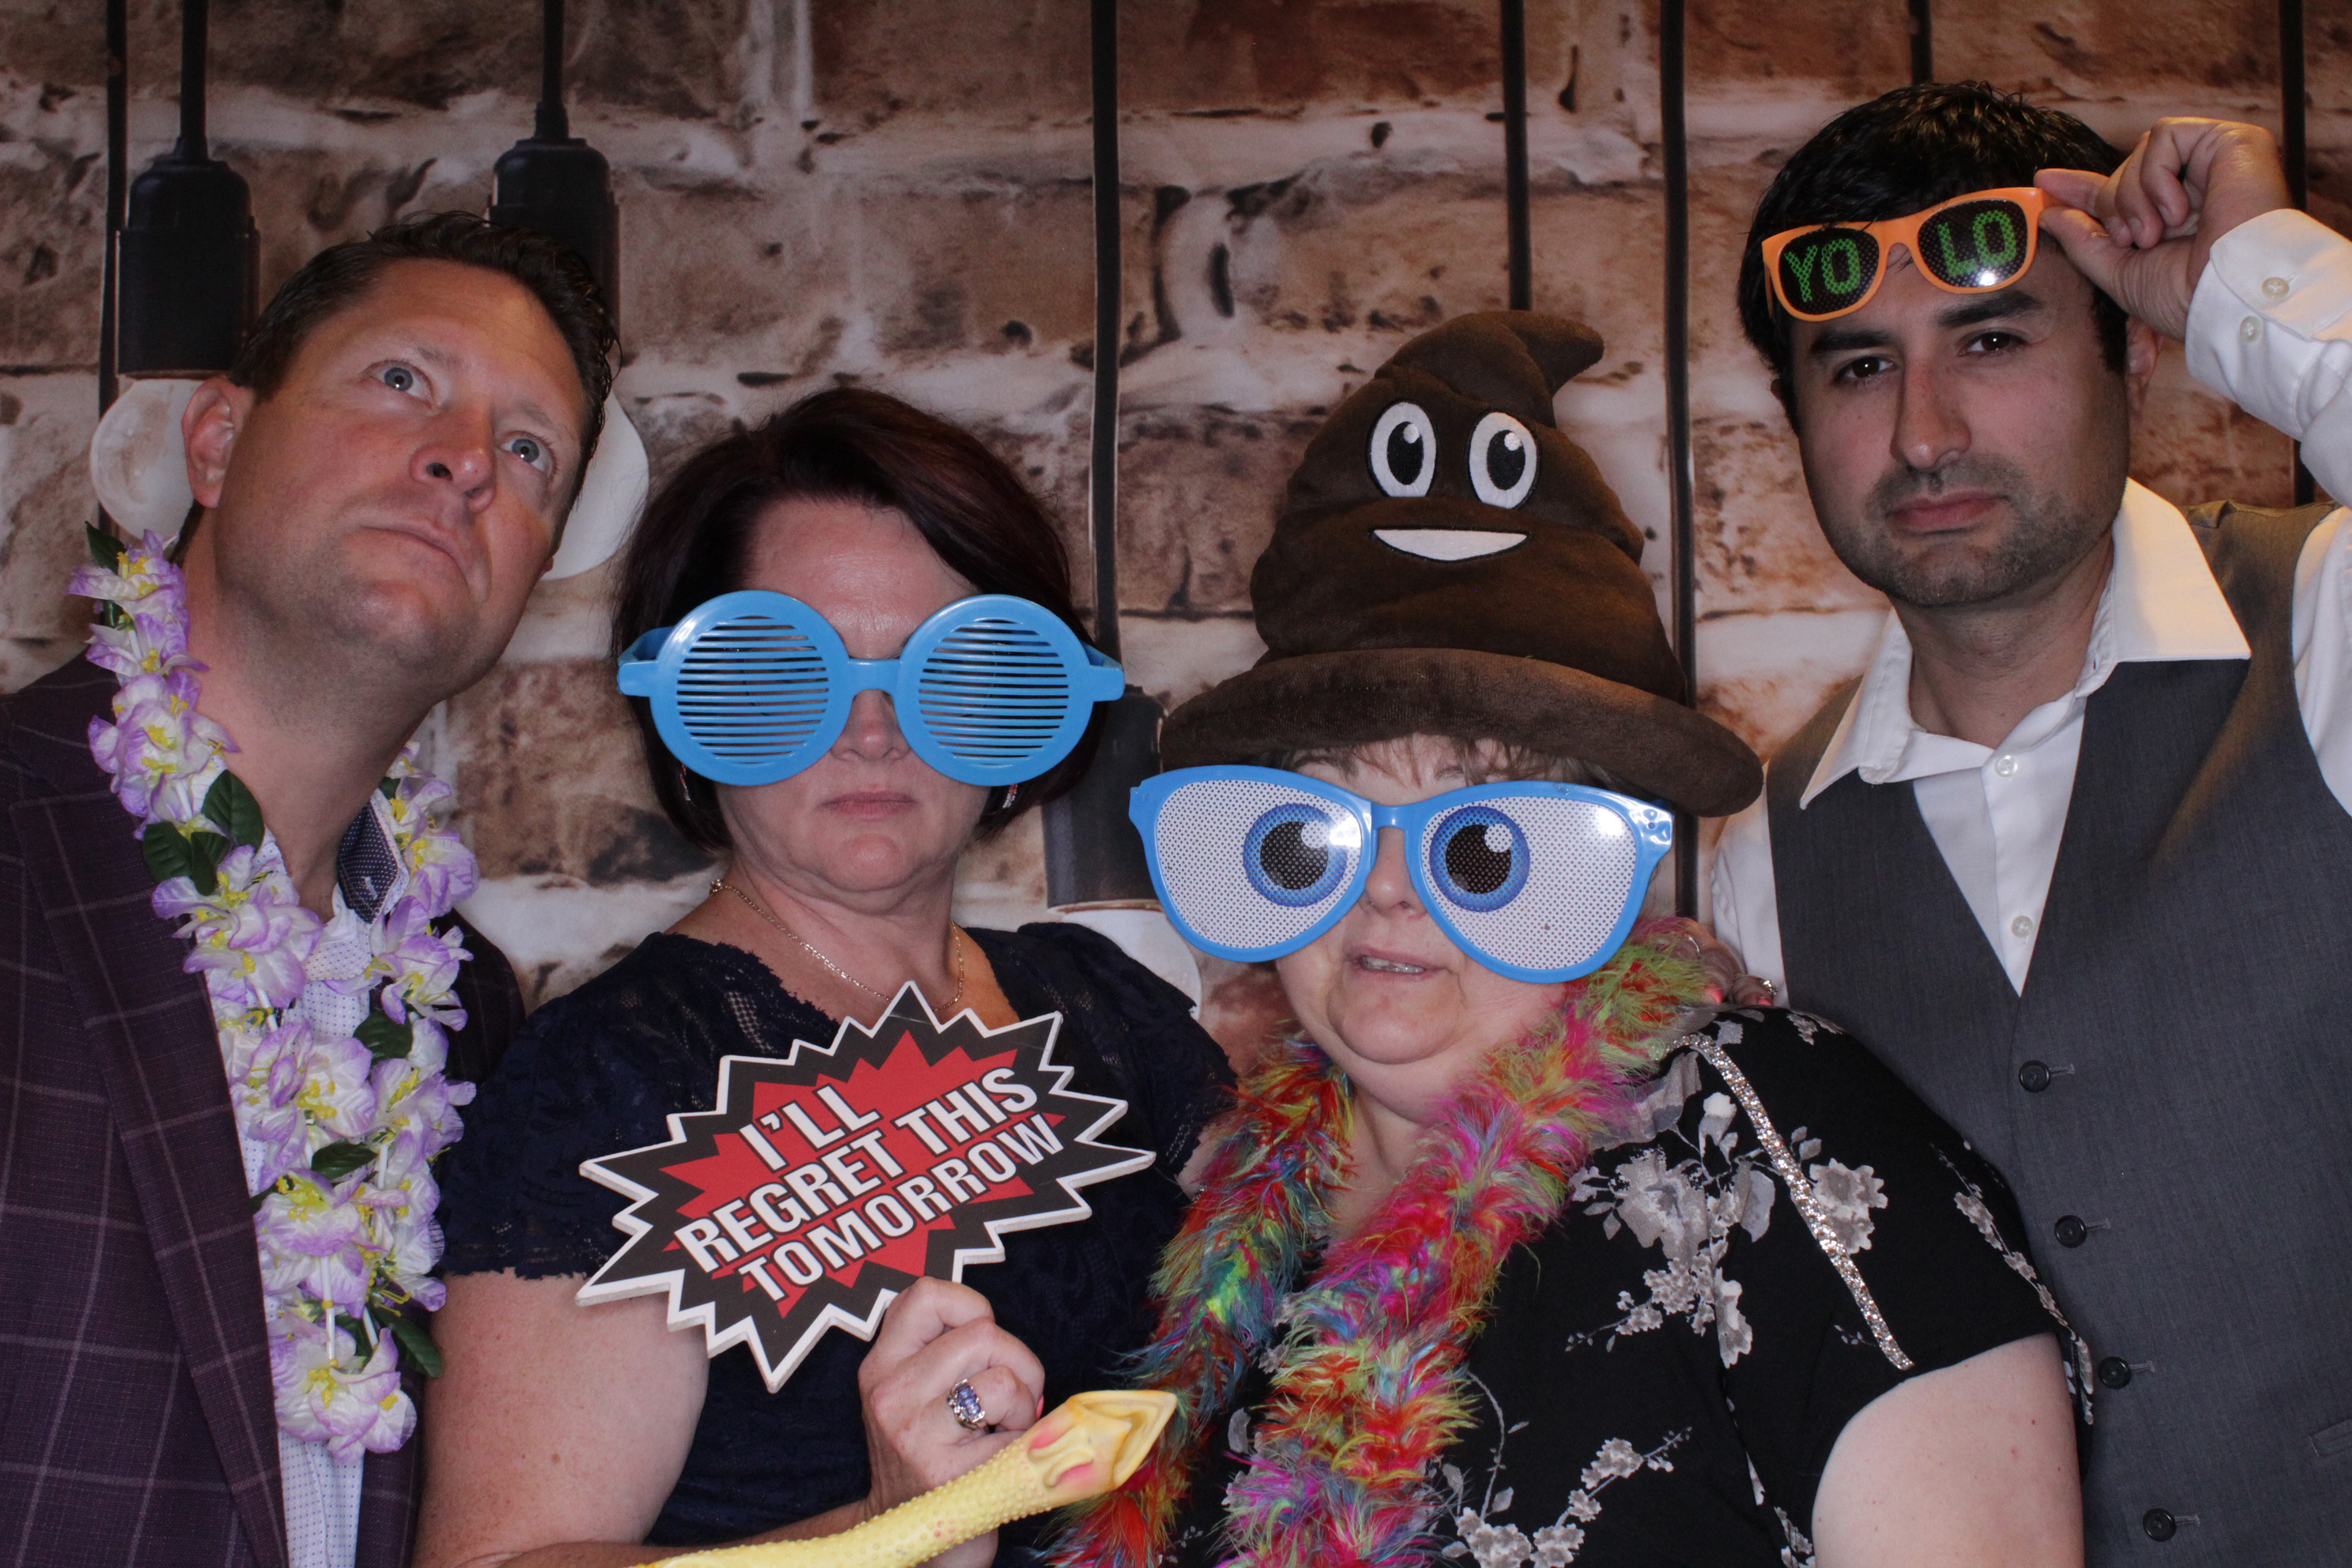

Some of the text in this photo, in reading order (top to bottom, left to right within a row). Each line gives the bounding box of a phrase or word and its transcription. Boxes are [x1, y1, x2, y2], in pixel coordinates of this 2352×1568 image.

[1784, 238, 1861, 302] YO
[674, 1067, 1038, 1273] REGRET THIS
[739, 1085, 880, 1171] I'LL
[738, 1114, 1064, 1301] TOMORROW
